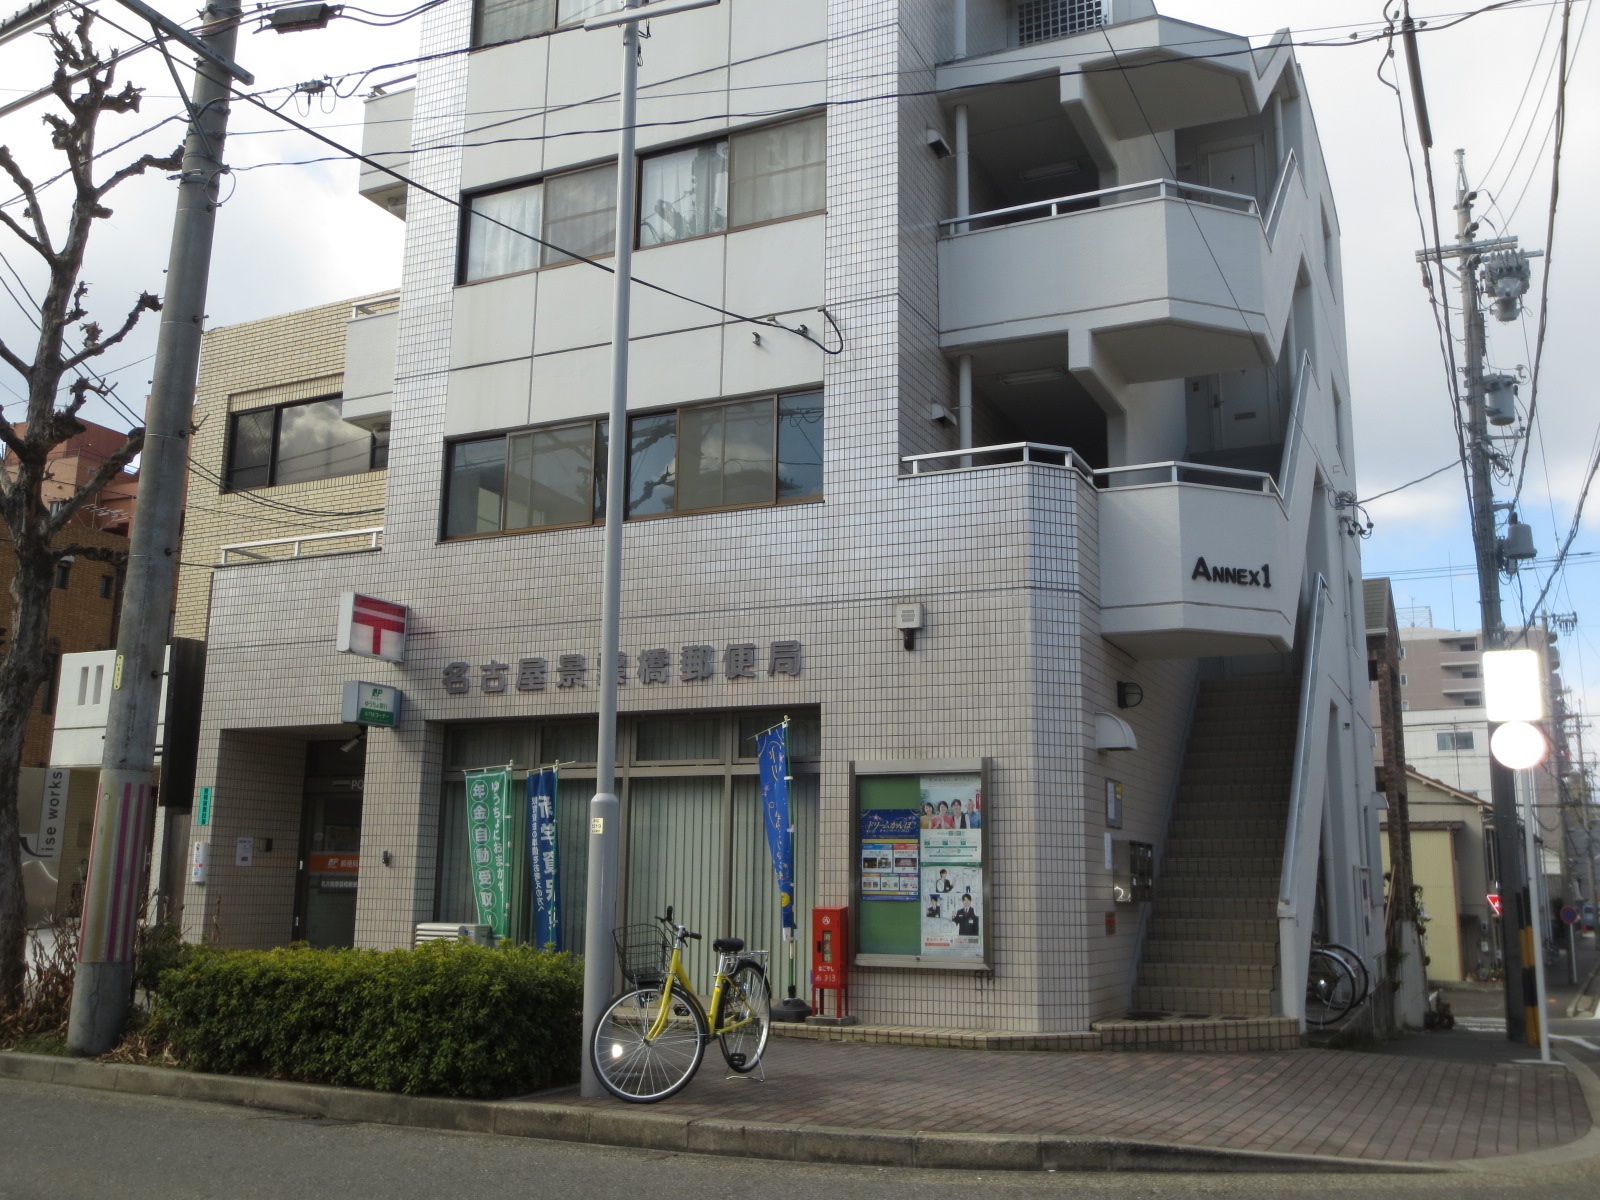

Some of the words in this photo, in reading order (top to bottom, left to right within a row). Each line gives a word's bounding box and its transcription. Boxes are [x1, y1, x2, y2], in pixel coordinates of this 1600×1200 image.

[1192, 556, 1271, 588] ANNEX1
[364, 701, 388, 710] ゆうちょ銀行
[48, 771, 63, 820] works
[473, 783, 493, 926] 年金自動受取り
[490, 780, 505, 892] ゆうちょにおまかせ
[824, 974, 836, 982] 313
